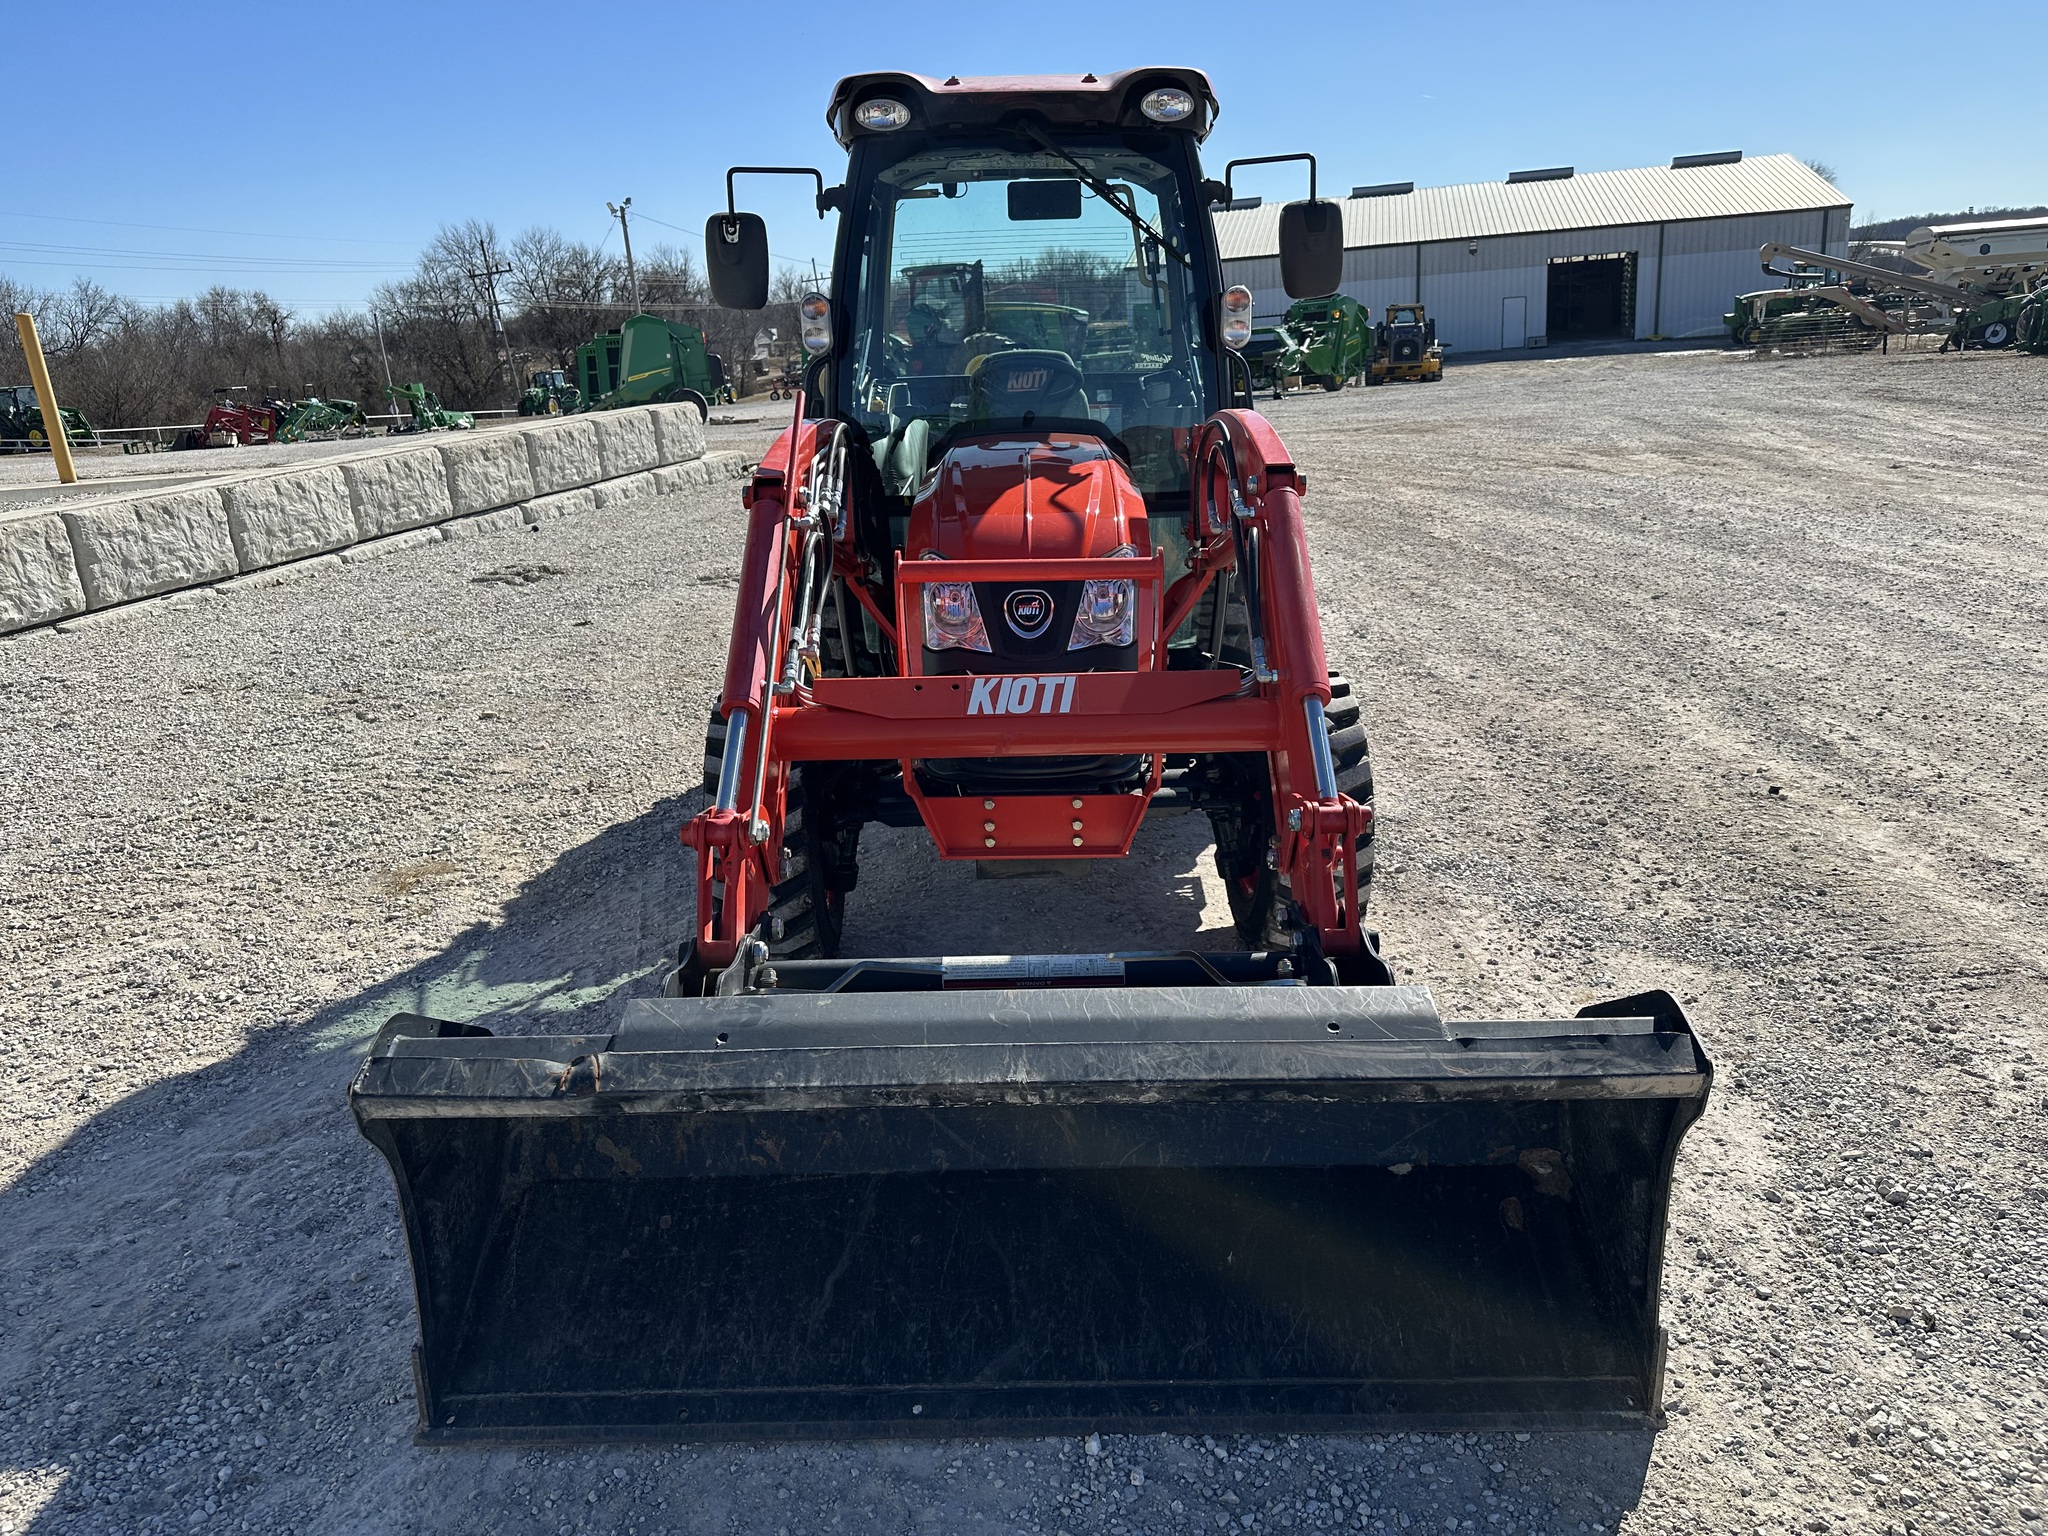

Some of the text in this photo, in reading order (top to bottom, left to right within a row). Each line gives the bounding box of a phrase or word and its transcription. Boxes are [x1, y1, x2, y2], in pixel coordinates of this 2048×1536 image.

[1007, 370, 1047, 387] KIOTI
[1018, 604, 1040, 615] KIOTI
[967, 676, 1076, 716] KIOTI
